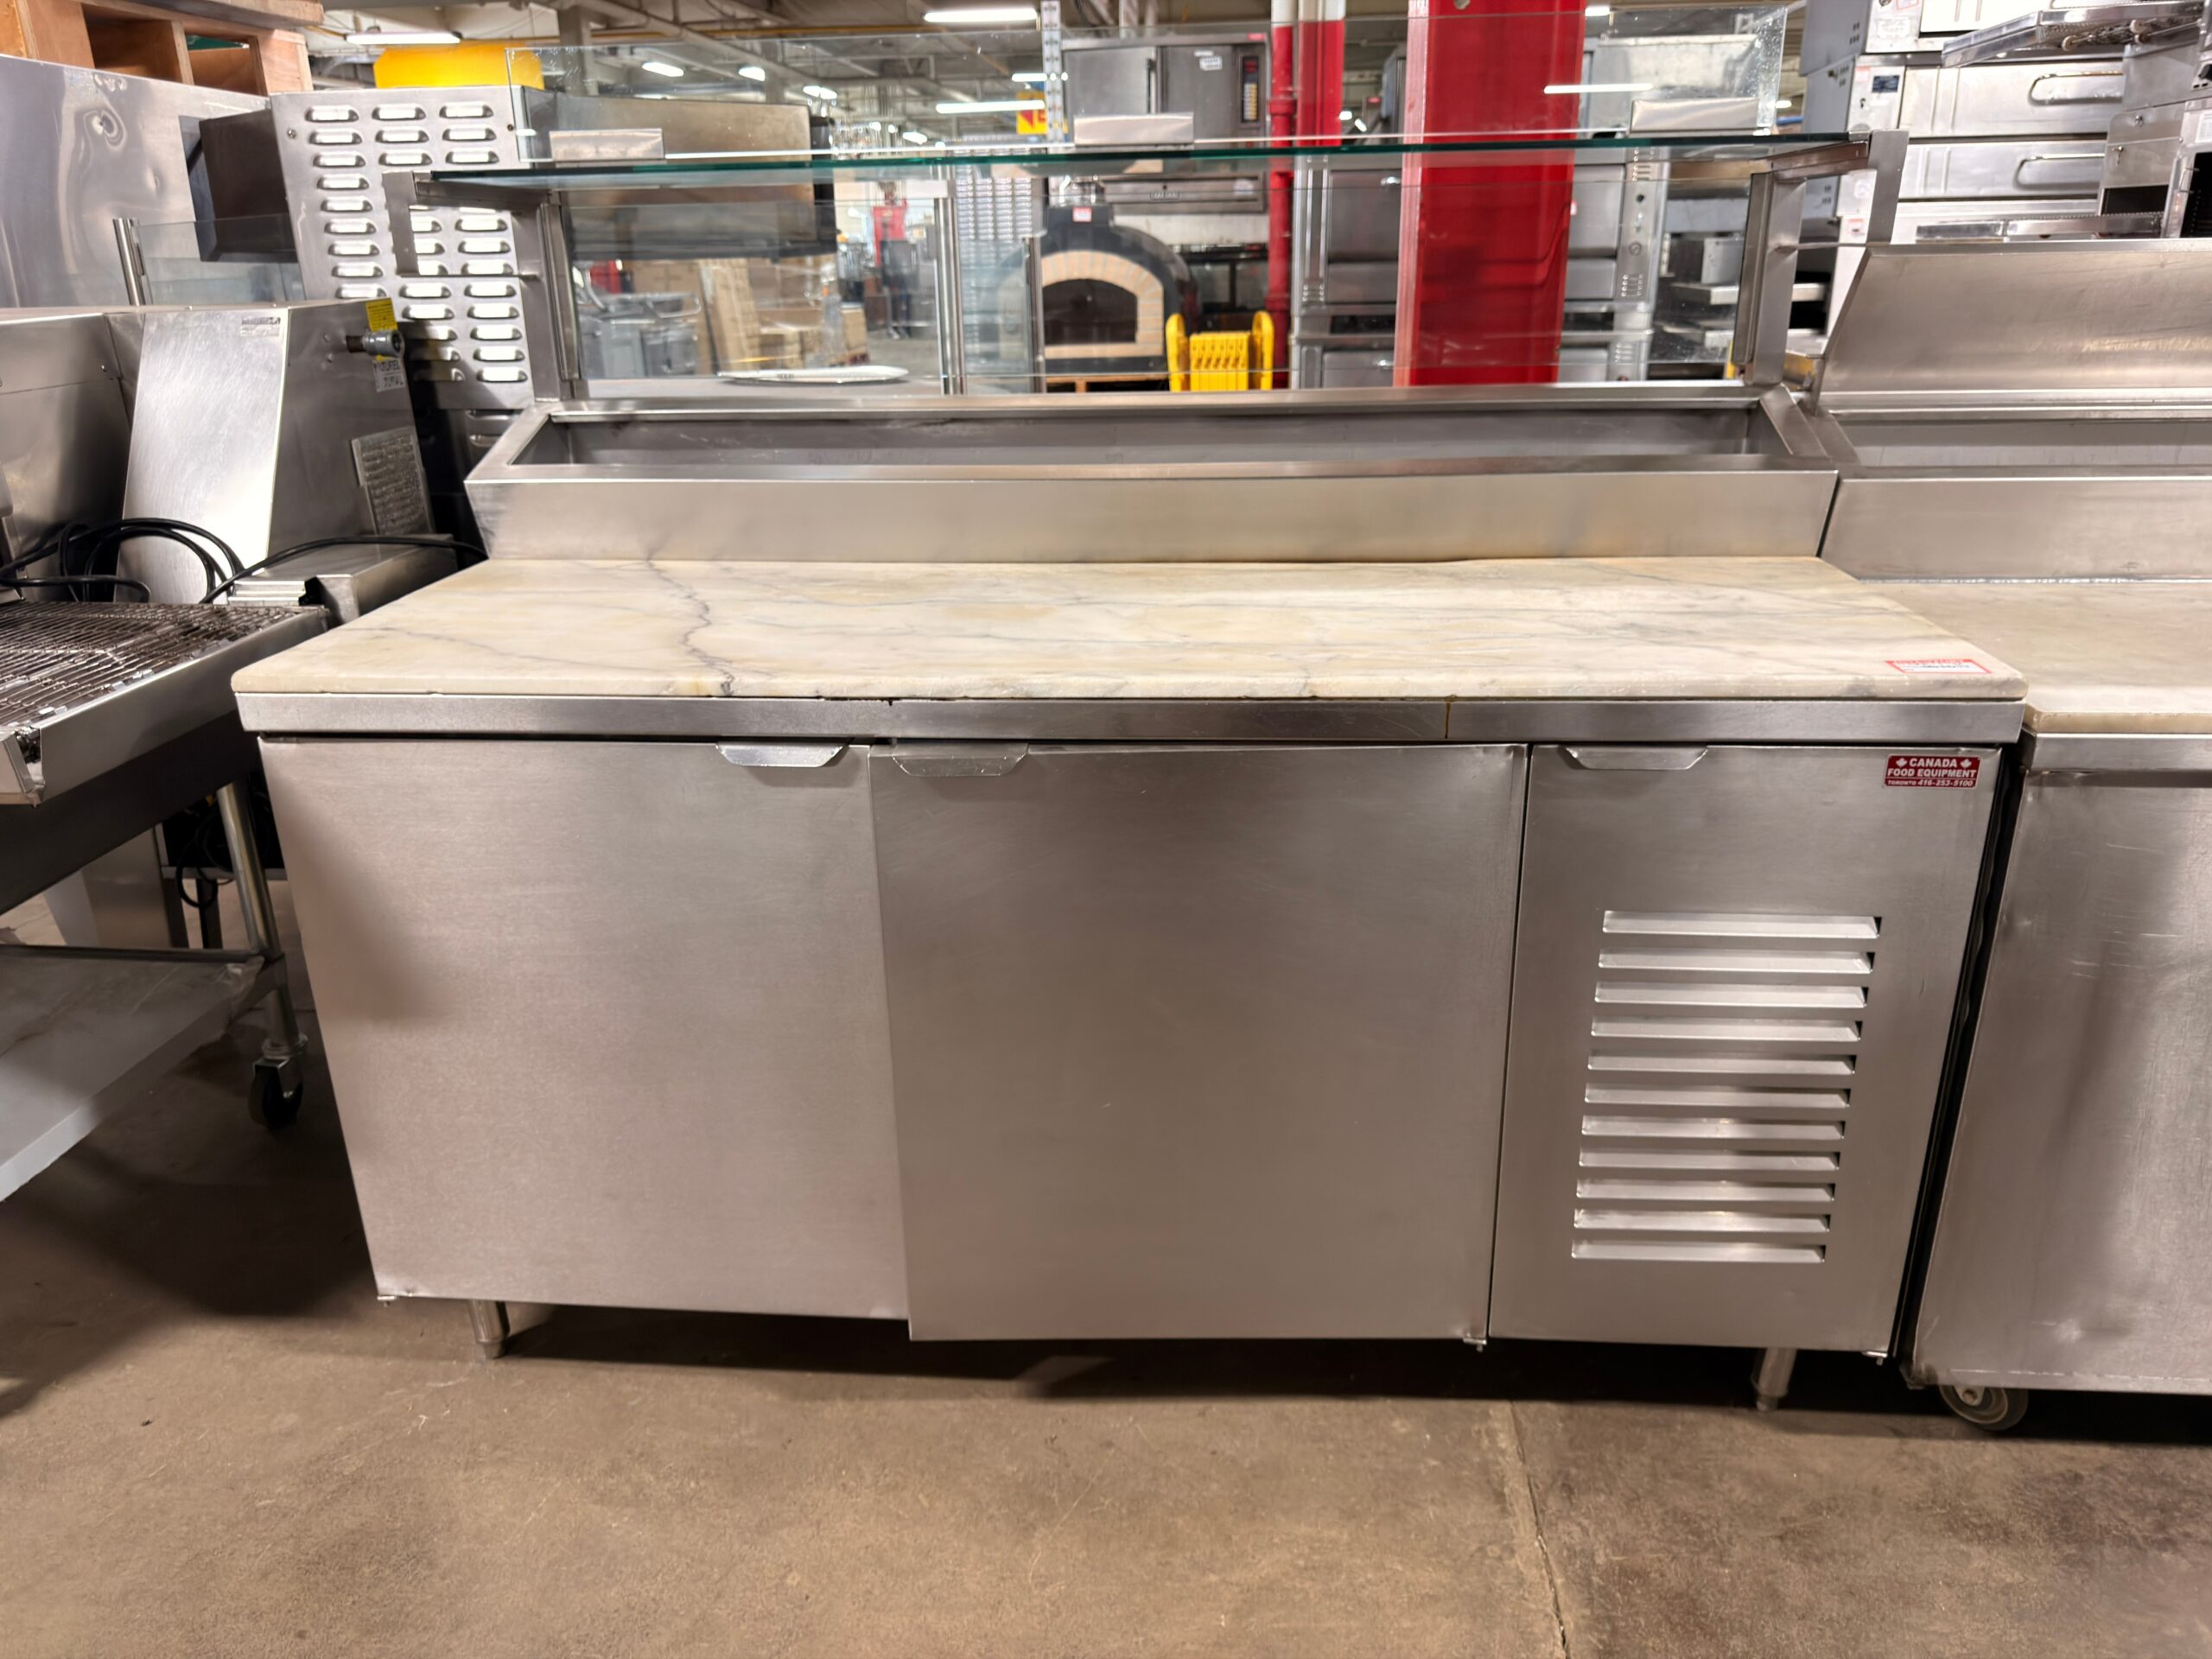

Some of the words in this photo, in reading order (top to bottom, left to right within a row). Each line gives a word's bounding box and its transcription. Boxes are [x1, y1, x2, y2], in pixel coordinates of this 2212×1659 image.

[1910, 758, 1957, 767] CANADA
[1887, 768, 1915, 777] FOOD
[1916, 769, 1977, 778] EQUIPMENT
